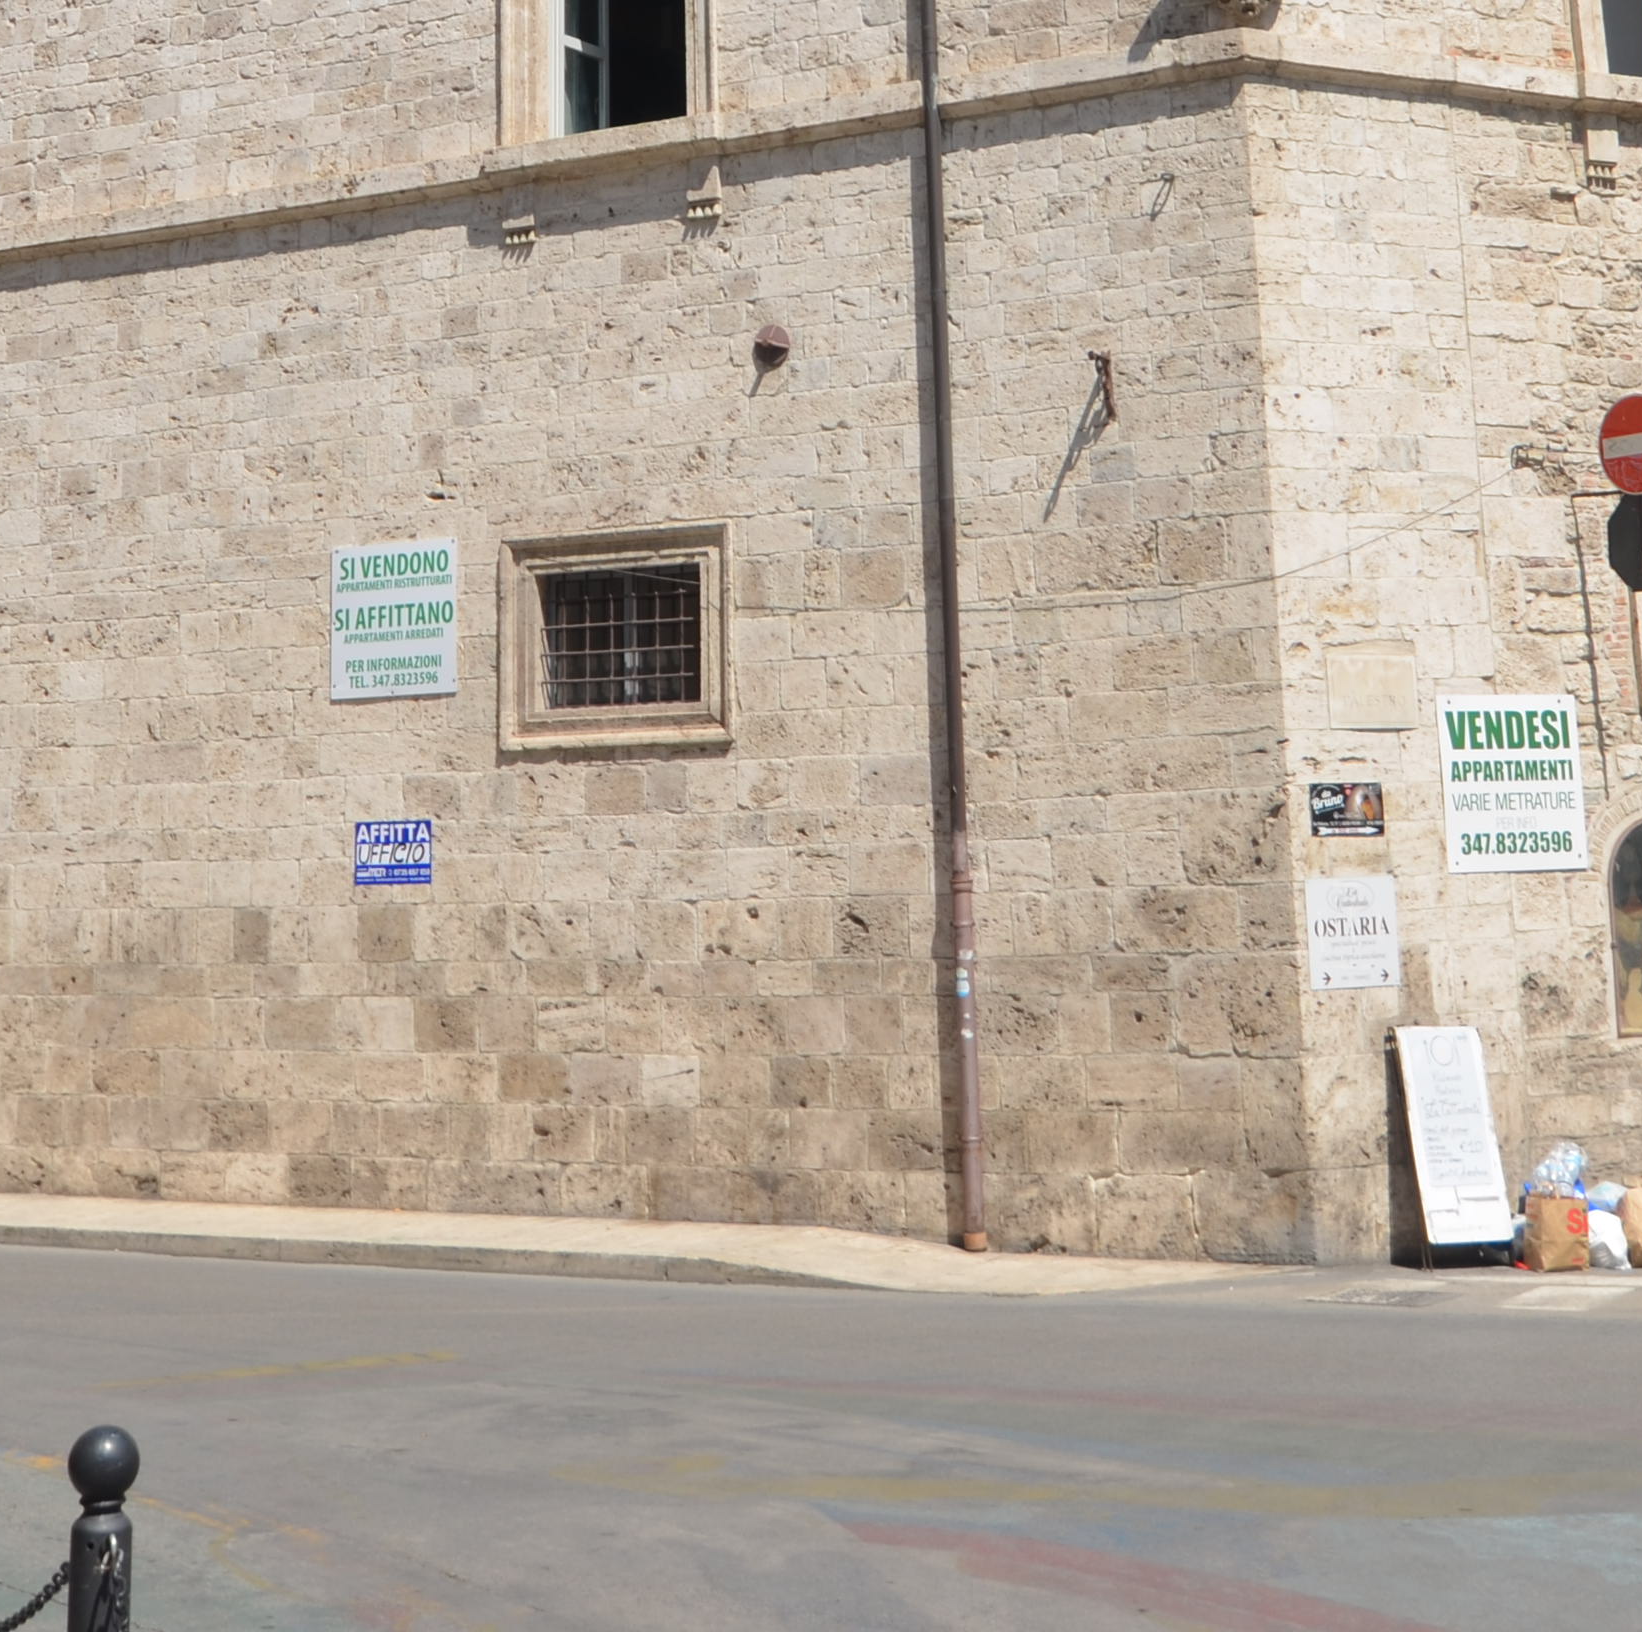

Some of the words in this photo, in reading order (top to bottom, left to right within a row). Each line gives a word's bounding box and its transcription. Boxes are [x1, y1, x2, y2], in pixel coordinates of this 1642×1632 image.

[340, 557, 355, 581] SI
[360, 549, 449, 579] VENDONO
[336, 578, 393, 593] APPARTAMENTI
[394, 574, 453, 589] RISTRUTTURATI
[334, 608, 350, 631] SI
[355, 600, 454, 630] AFFITTANO
[343, 630, 404, 644] APPARTAMENTI
[405, 627, 444, 641] ARREDATI
[345, 659, 365, 673] PER
[366, 654, 442, 671] INFORMAZIONI
[349, 675, 369, 689] TEL.
[371, 671, 439, 688] 347.8323596
[1444, 709, 1571, 750] VENDESI
[1451, 759, 1574, 782] APPARTAMENTI
[1311, 794, 1344, 810] Bruno
[1452, 792, 1492, 812] VARIE
[1495, 791, 1576, 811] METRATURE
[357, 822, 430, 843] AFFITTA
[1461, 830, 1573, 855] 347.8323596
[358, 842, 425, 864] UFFICIO
[1314, 916, 1390, 938] OSTARIA
